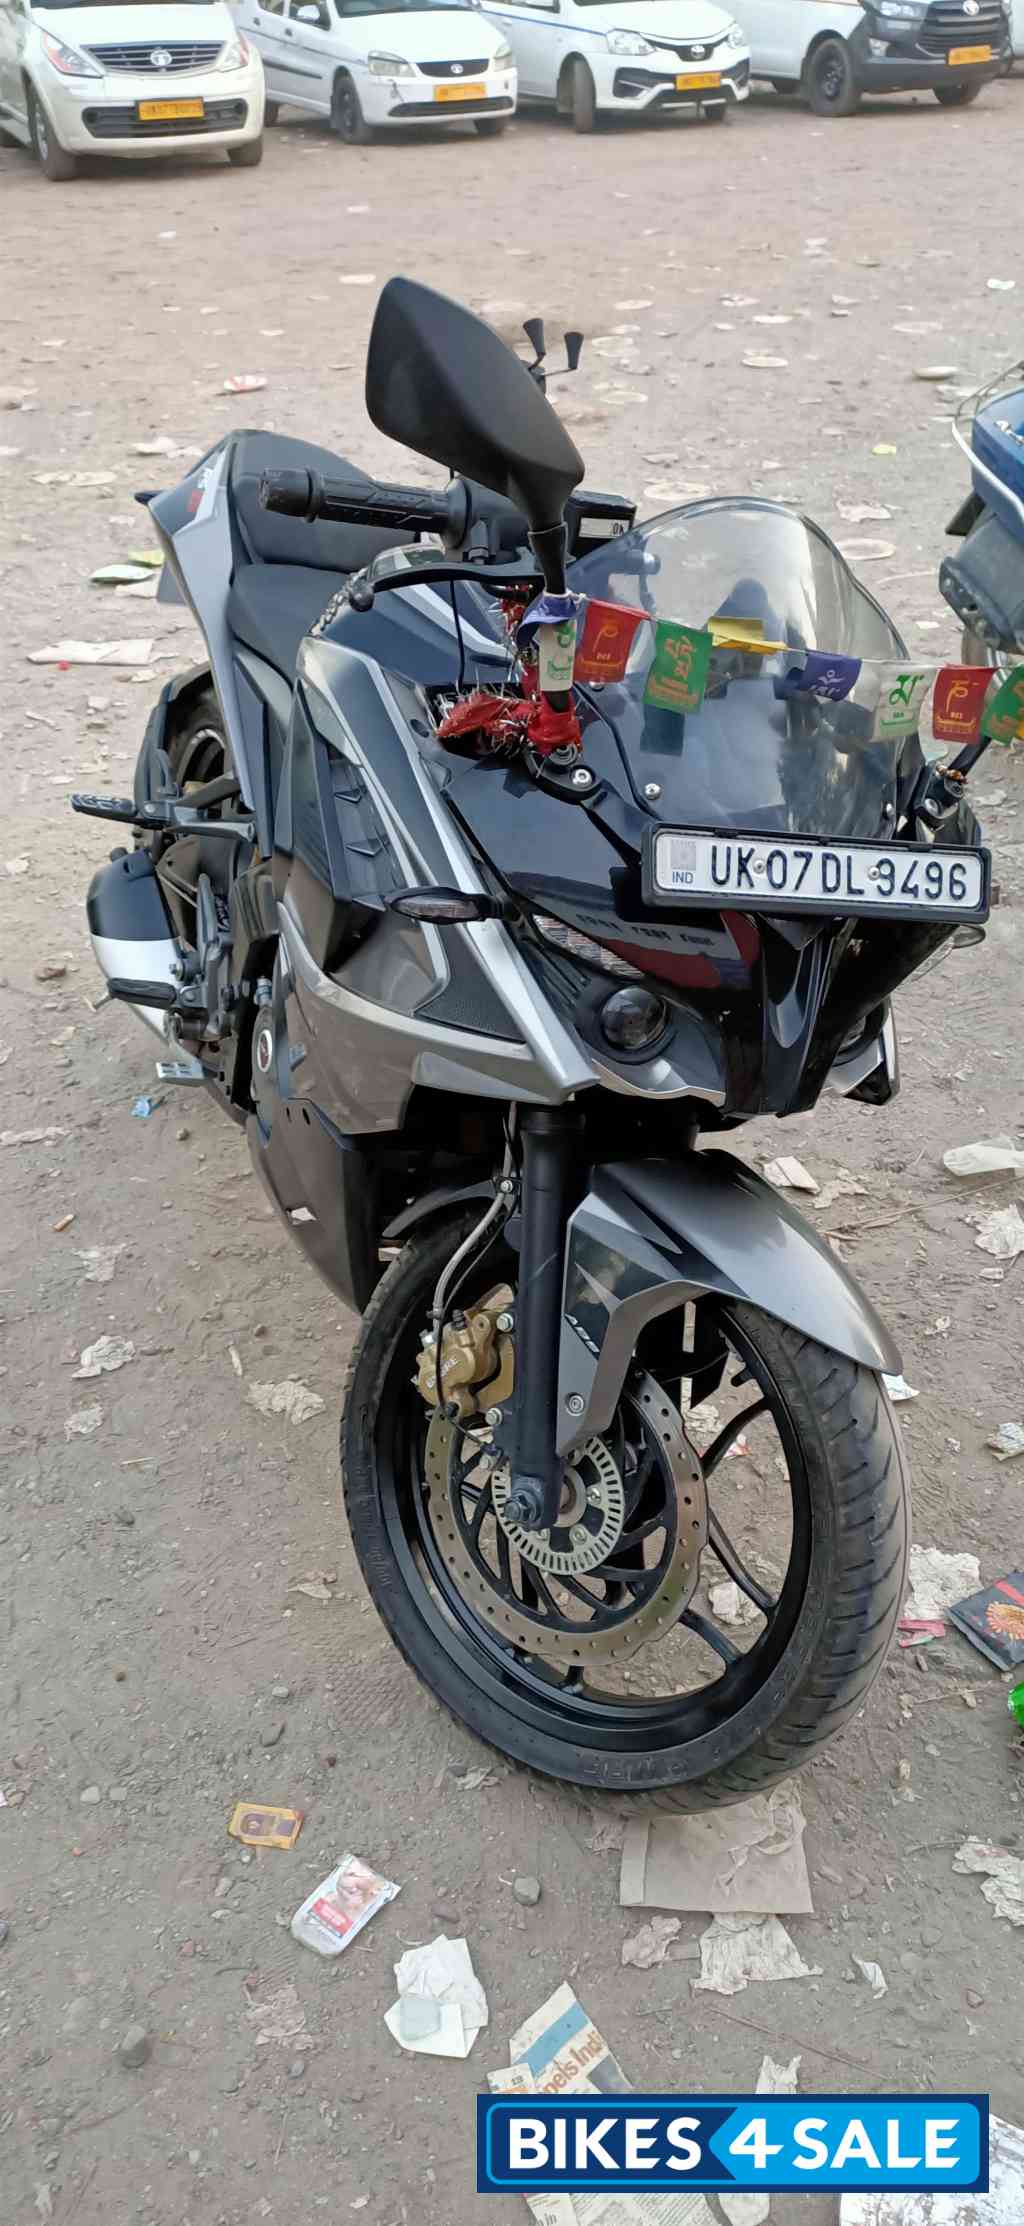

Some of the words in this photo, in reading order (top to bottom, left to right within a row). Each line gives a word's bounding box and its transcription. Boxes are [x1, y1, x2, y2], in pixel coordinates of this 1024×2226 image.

[671, 871, 694, 884] IND
[711, 846, 756, 888] UK
[875, 857, 967, 901] 9496
